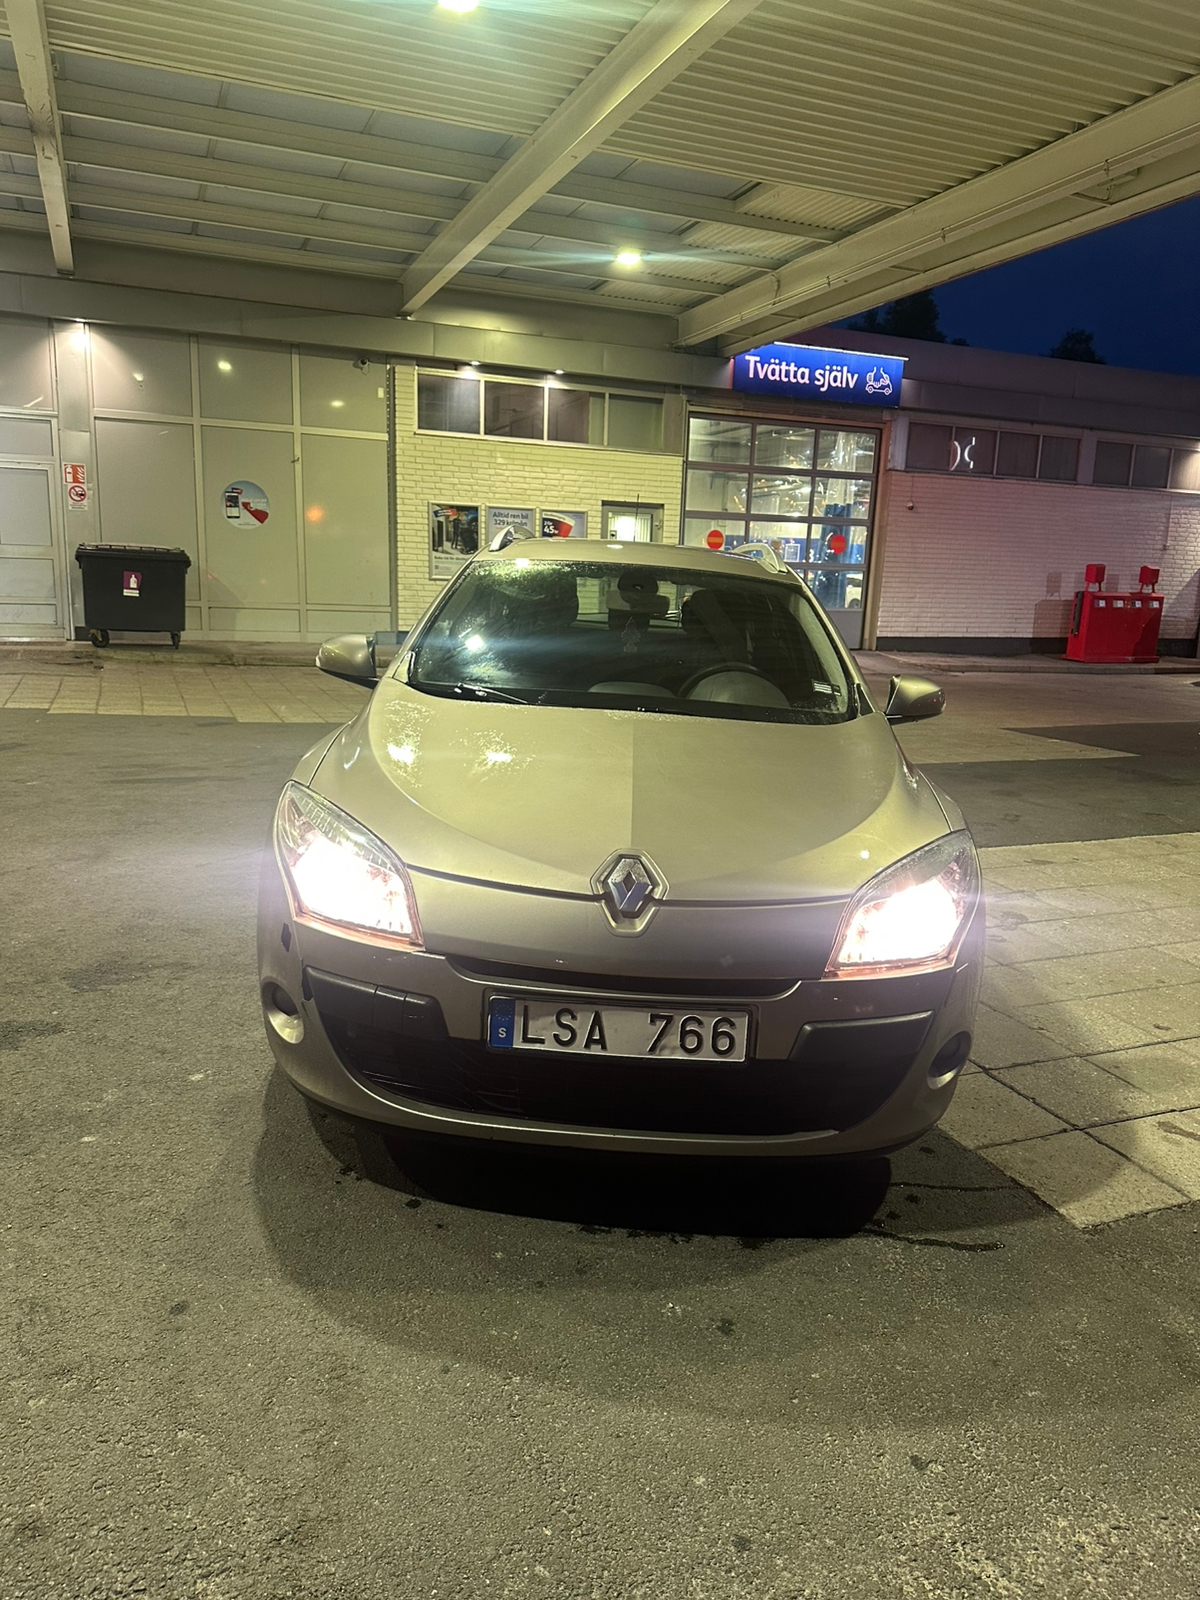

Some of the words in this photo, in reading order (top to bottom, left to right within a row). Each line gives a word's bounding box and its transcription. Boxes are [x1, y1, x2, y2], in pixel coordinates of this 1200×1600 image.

[744, 355, 809, 384] Tvätta
[814, 365, 859, 392] själv
[492, 511, 510, 519] Alltid
[493, 518, 506, 526] 329
[543, 525, 555, 534] 45
[498, 1027, 507, 1038] S
[520, 1005, 608, 1051] LSA
[646, 1012, 738, 1056] 766
